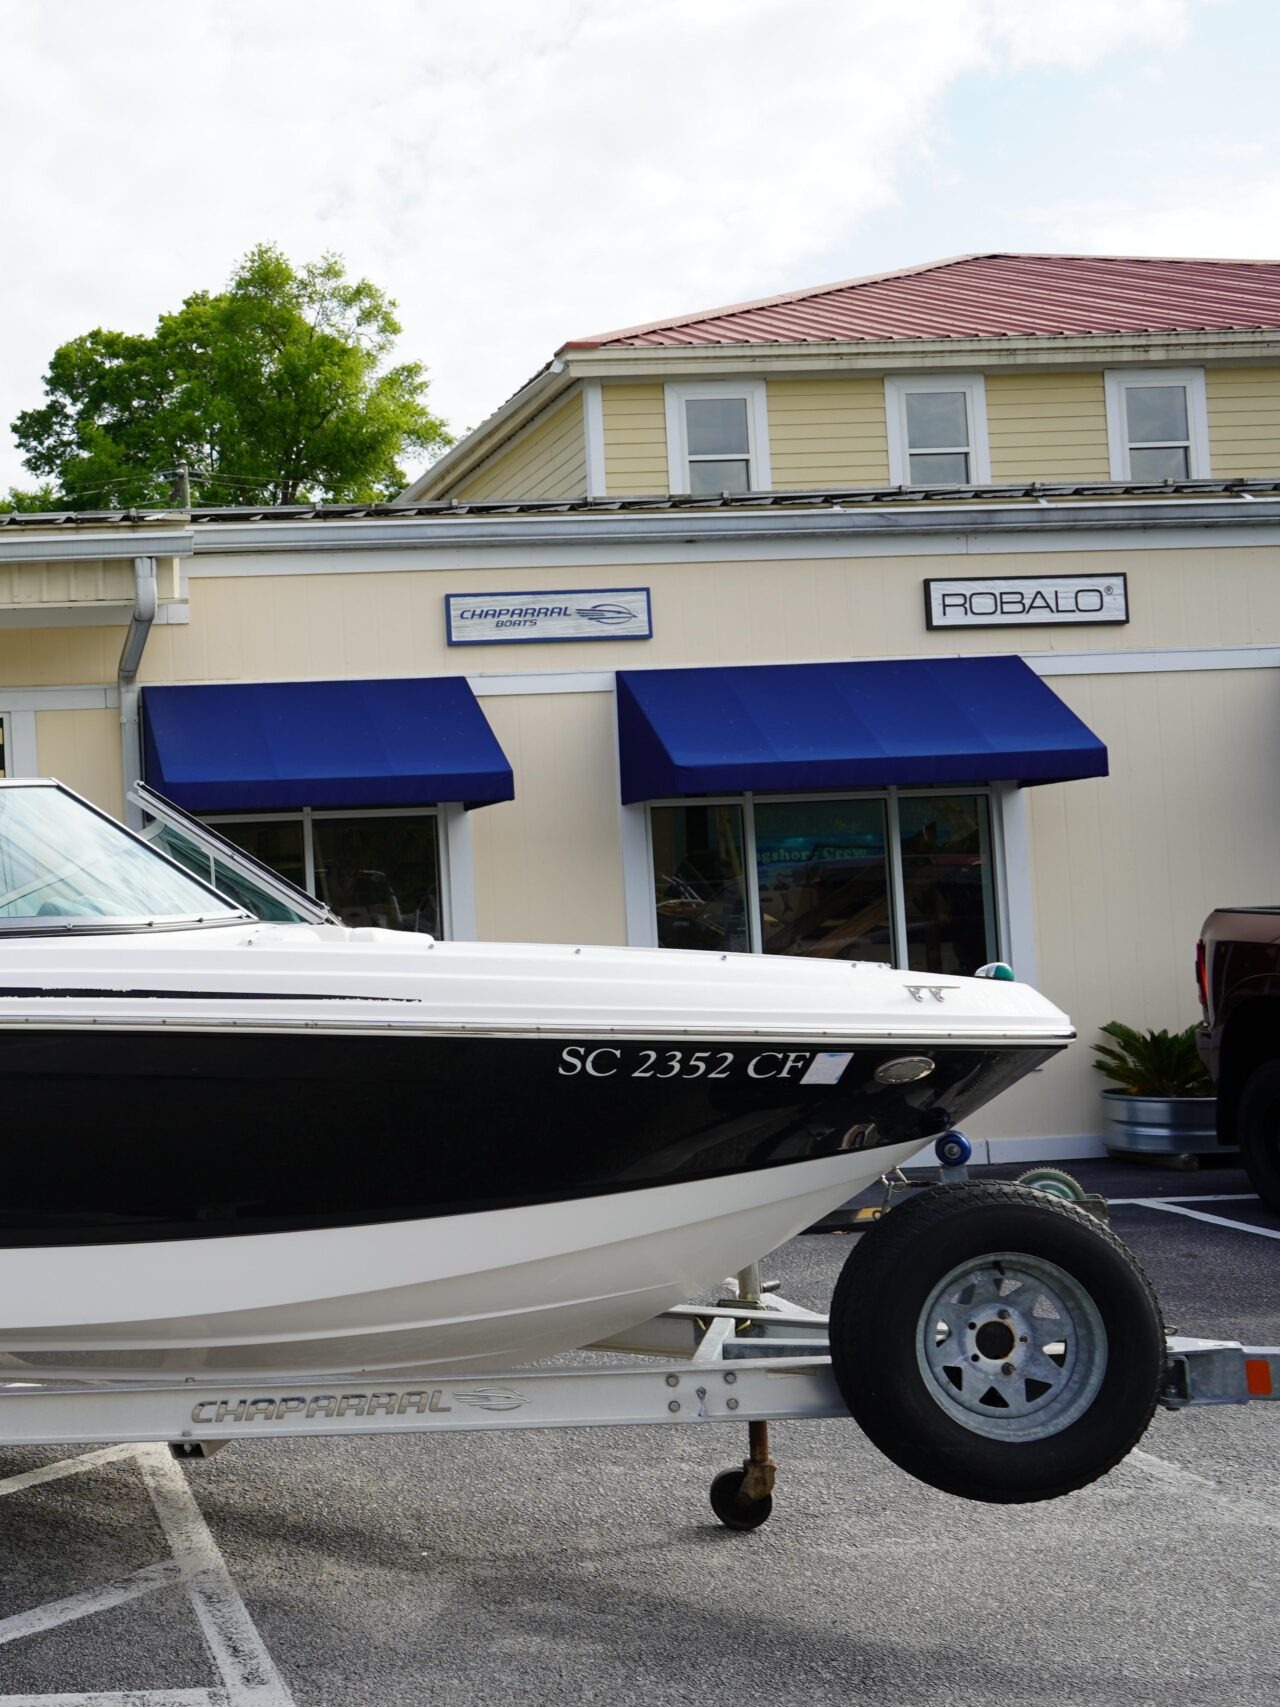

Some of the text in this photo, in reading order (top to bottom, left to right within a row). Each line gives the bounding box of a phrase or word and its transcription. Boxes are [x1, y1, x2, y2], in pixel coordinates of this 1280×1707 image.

[460, 606, 573, 620] CHAPARRAL
[495, 618, 538, 628] BOATS
[558, 1046, 811, 1079] SC 2352 CF
[191, 1389, 452, 1424] CHAPARRAL
